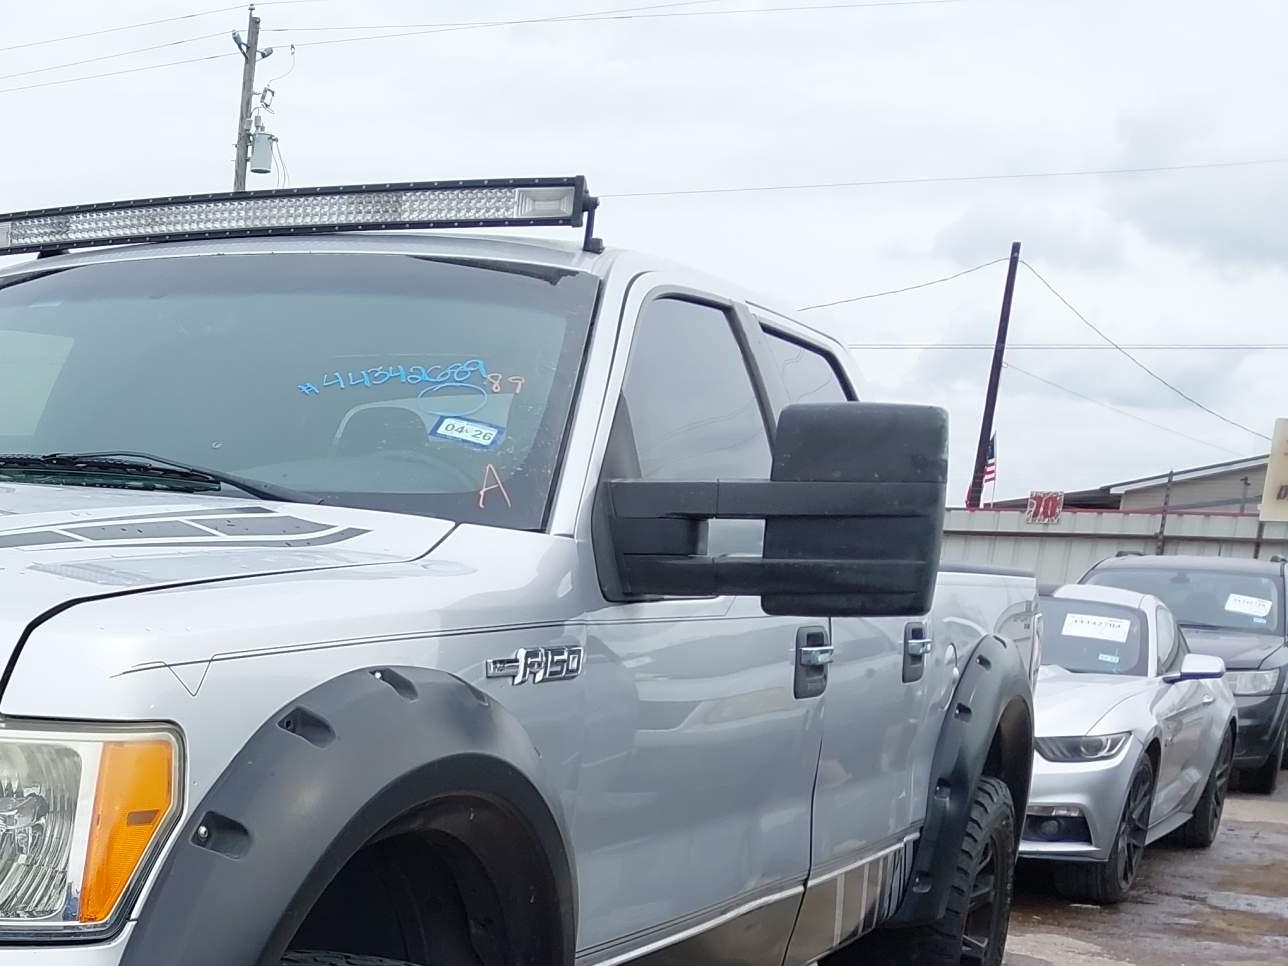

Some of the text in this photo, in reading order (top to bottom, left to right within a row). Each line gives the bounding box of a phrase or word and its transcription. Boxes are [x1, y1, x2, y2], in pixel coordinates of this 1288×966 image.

[444, 422, 494, 441] 04 26
[479, 463, 512, 509] A
